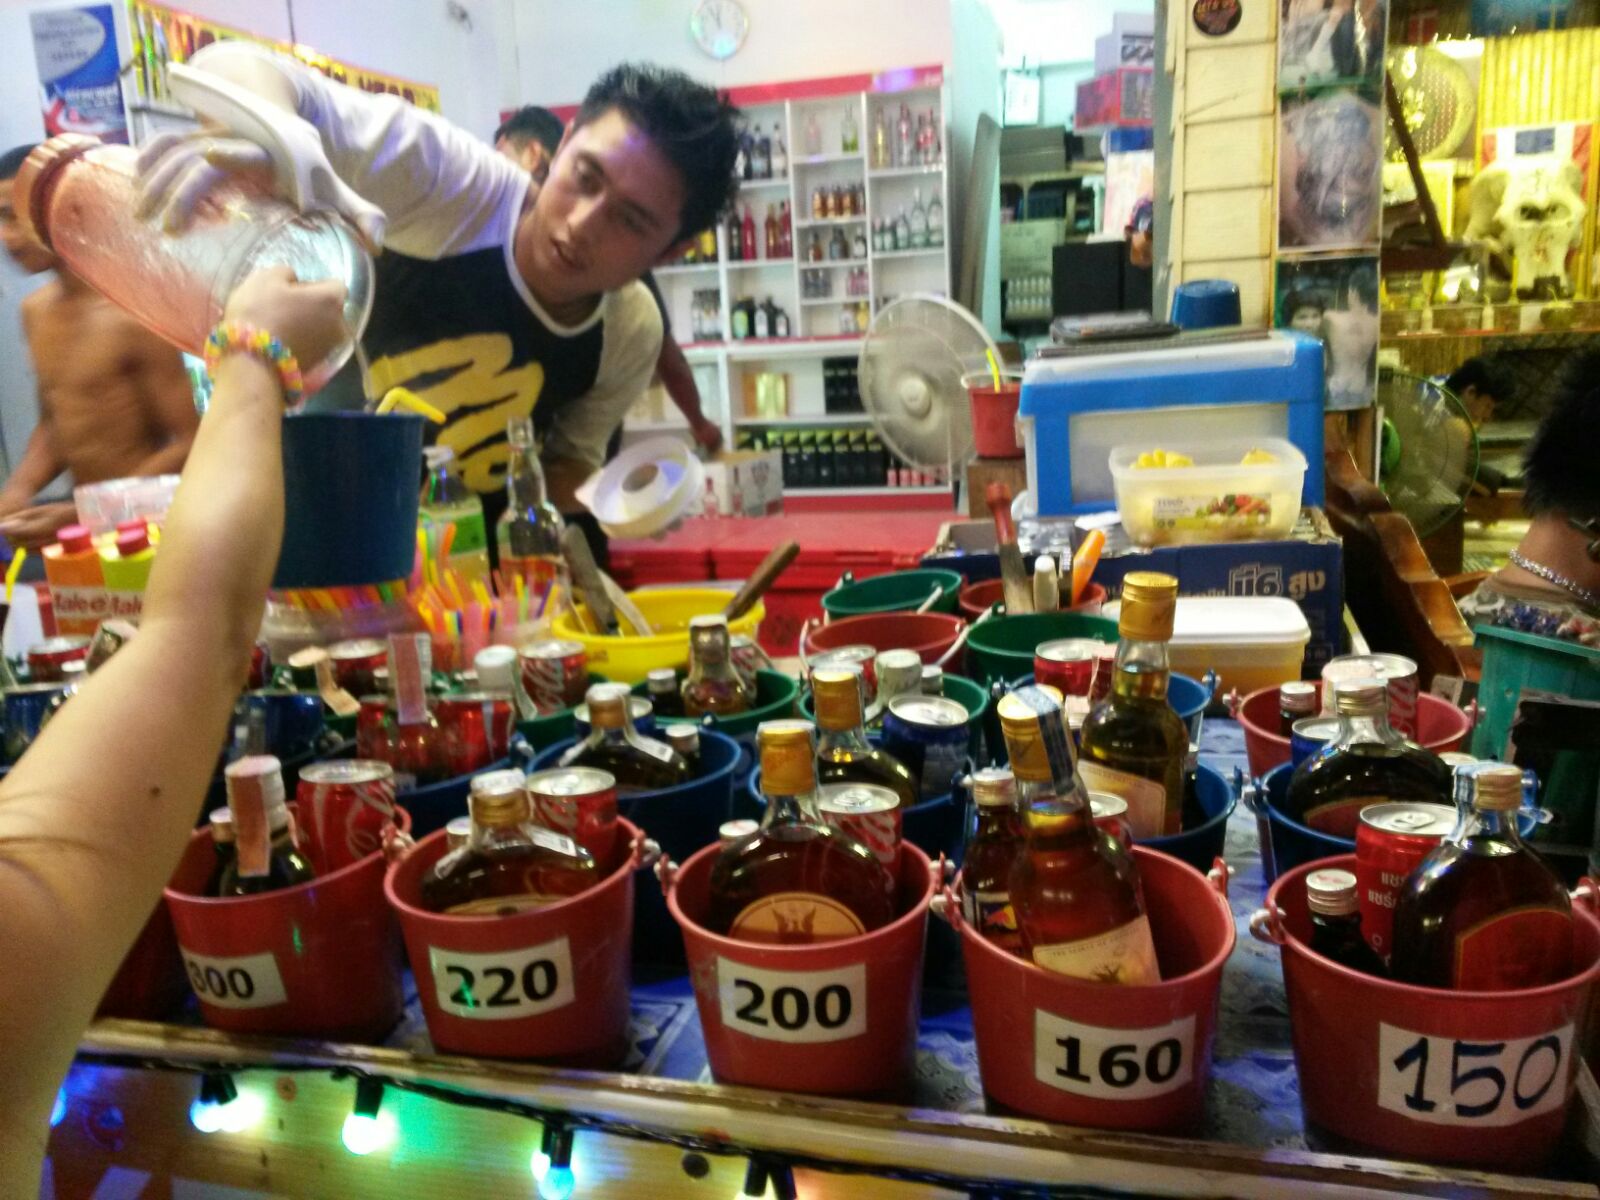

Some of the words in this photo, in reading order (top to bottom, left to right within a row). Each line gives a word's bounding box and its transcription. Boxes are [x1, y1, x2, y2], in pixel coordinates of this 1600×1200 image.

[189, 961, 255, 999] 300
[446, 959, 559, 1008] 220
[733, 979, 852, 1031] 200
[1054, 1036, 1183, 1088] 160
[1393, 1035, 1562, 1117] 150
